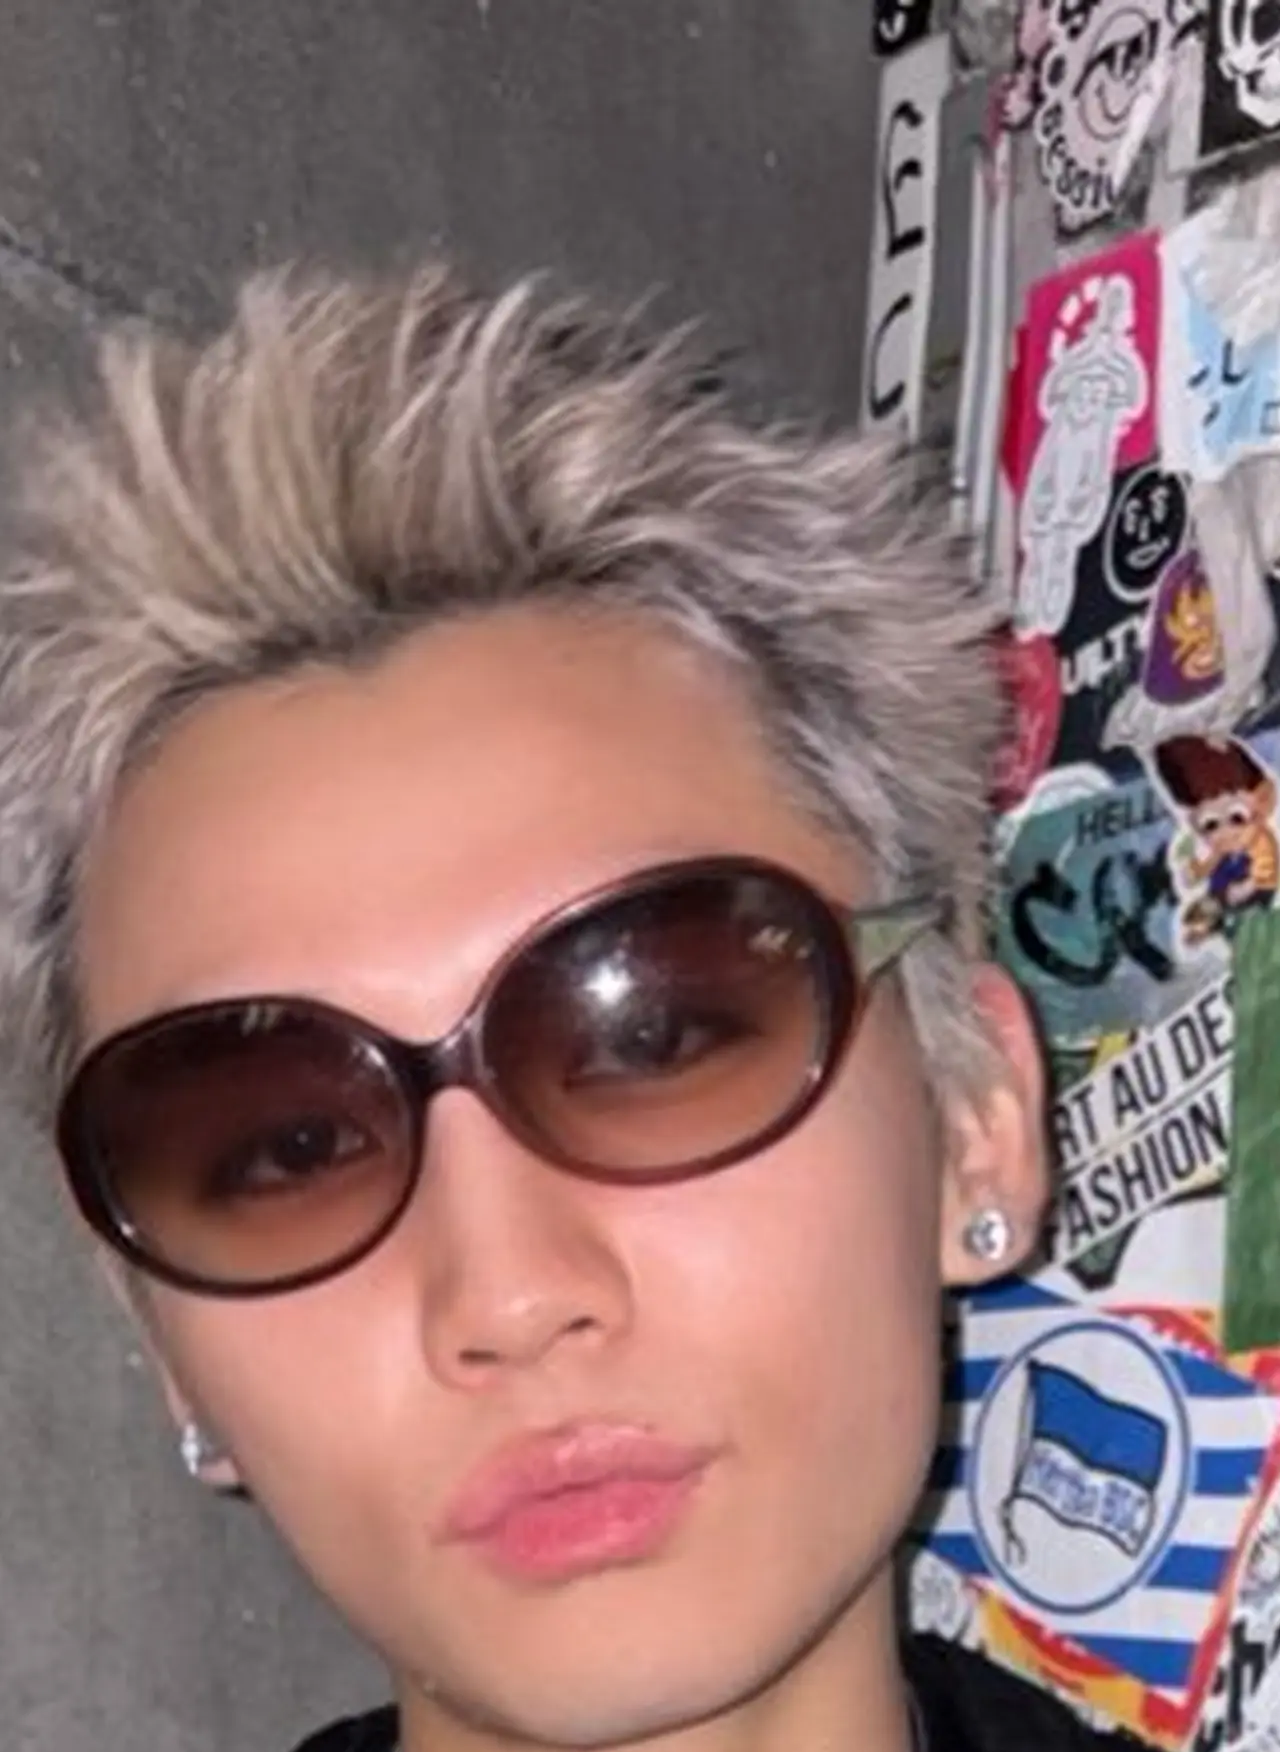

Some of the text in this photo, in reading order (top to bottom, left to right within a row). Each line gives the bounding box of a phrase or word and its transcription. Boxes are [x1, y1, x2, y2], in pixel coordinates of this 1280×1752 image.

[1076, 788, 1157, 847] HELL
[1111, 1040, 1168, 1126] AU
[1058, 1090, 1227, 1251] ASHION
